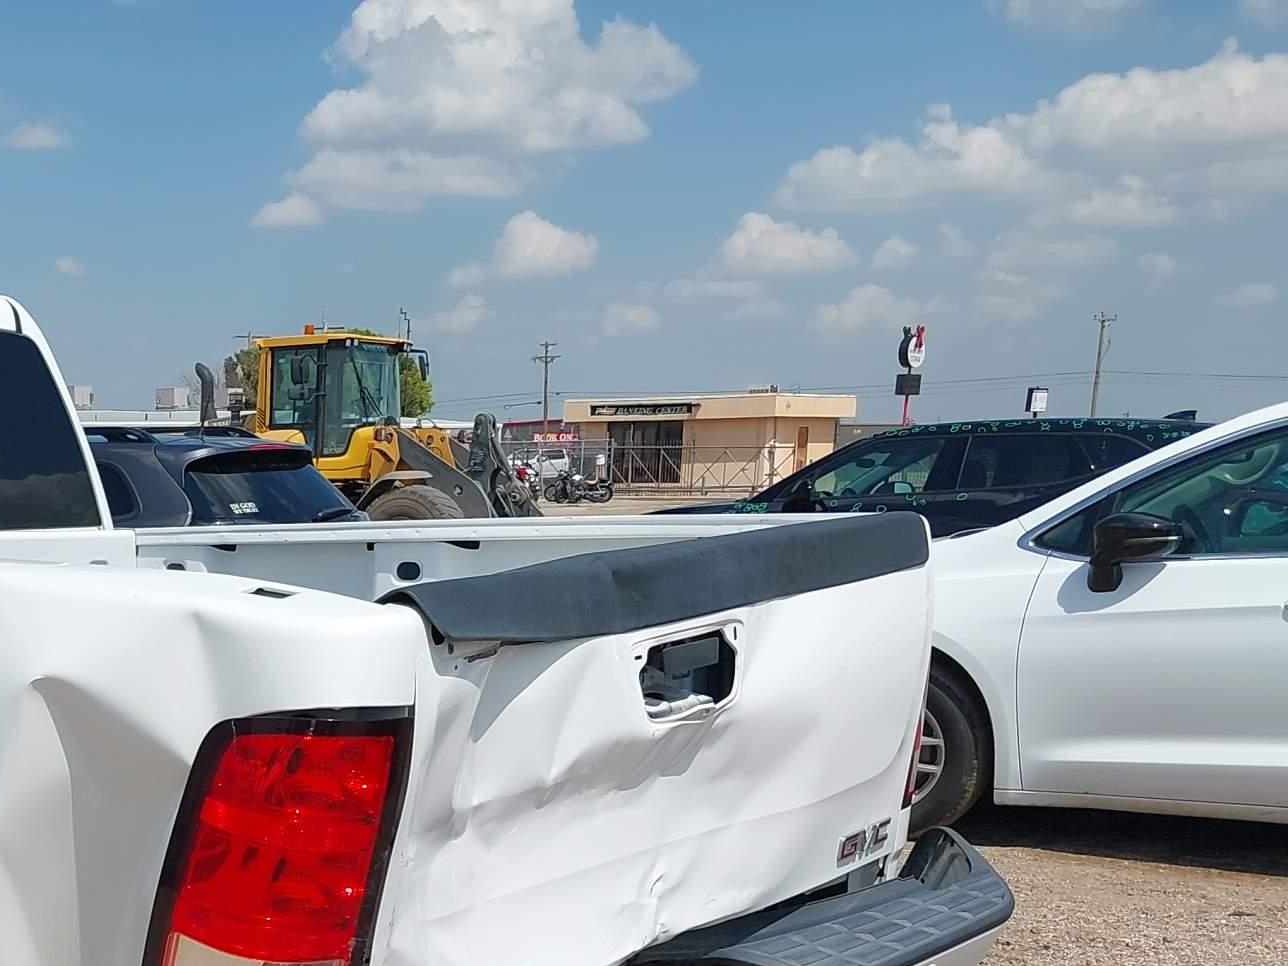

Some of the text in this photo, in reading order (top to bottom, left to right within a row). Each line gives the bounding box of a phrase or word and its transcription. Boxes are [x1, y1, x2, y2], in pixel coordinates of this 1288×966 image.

[616, 407, 653, 415] BANKING
[655, 406, 688, 414] CENTER
[837, 817, 891, 868] GMC
